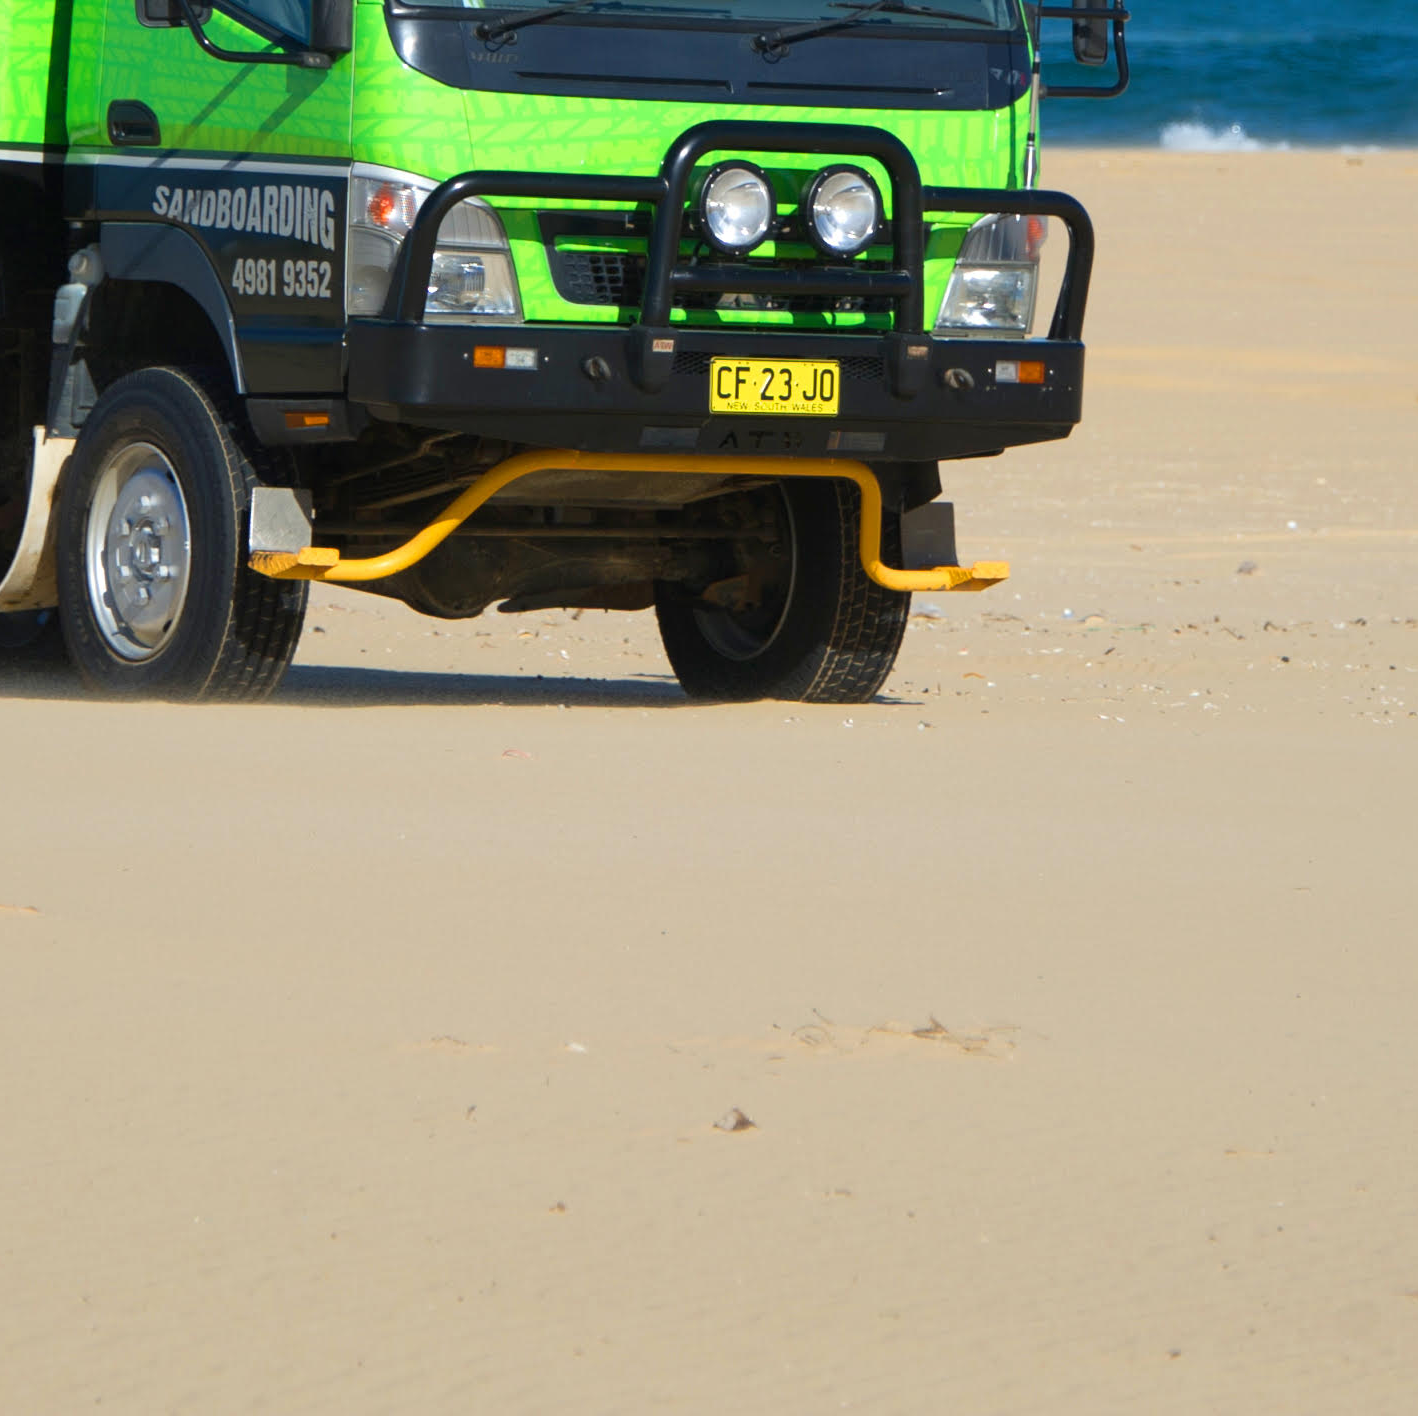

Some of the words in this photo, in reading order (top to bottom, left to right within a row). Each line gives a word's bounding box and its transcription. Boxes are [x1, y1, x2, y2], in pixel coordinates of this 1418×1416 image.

[152, 184, 336, 251] SANDBOARDING
[231, 257, 277, 296] 4981
[282, 259, 332, 299] 9352
[726, 402, 748, 411] NEW
[754, 402, 788, 412] SOUTH
[792, 404, 824, 413] WALES
